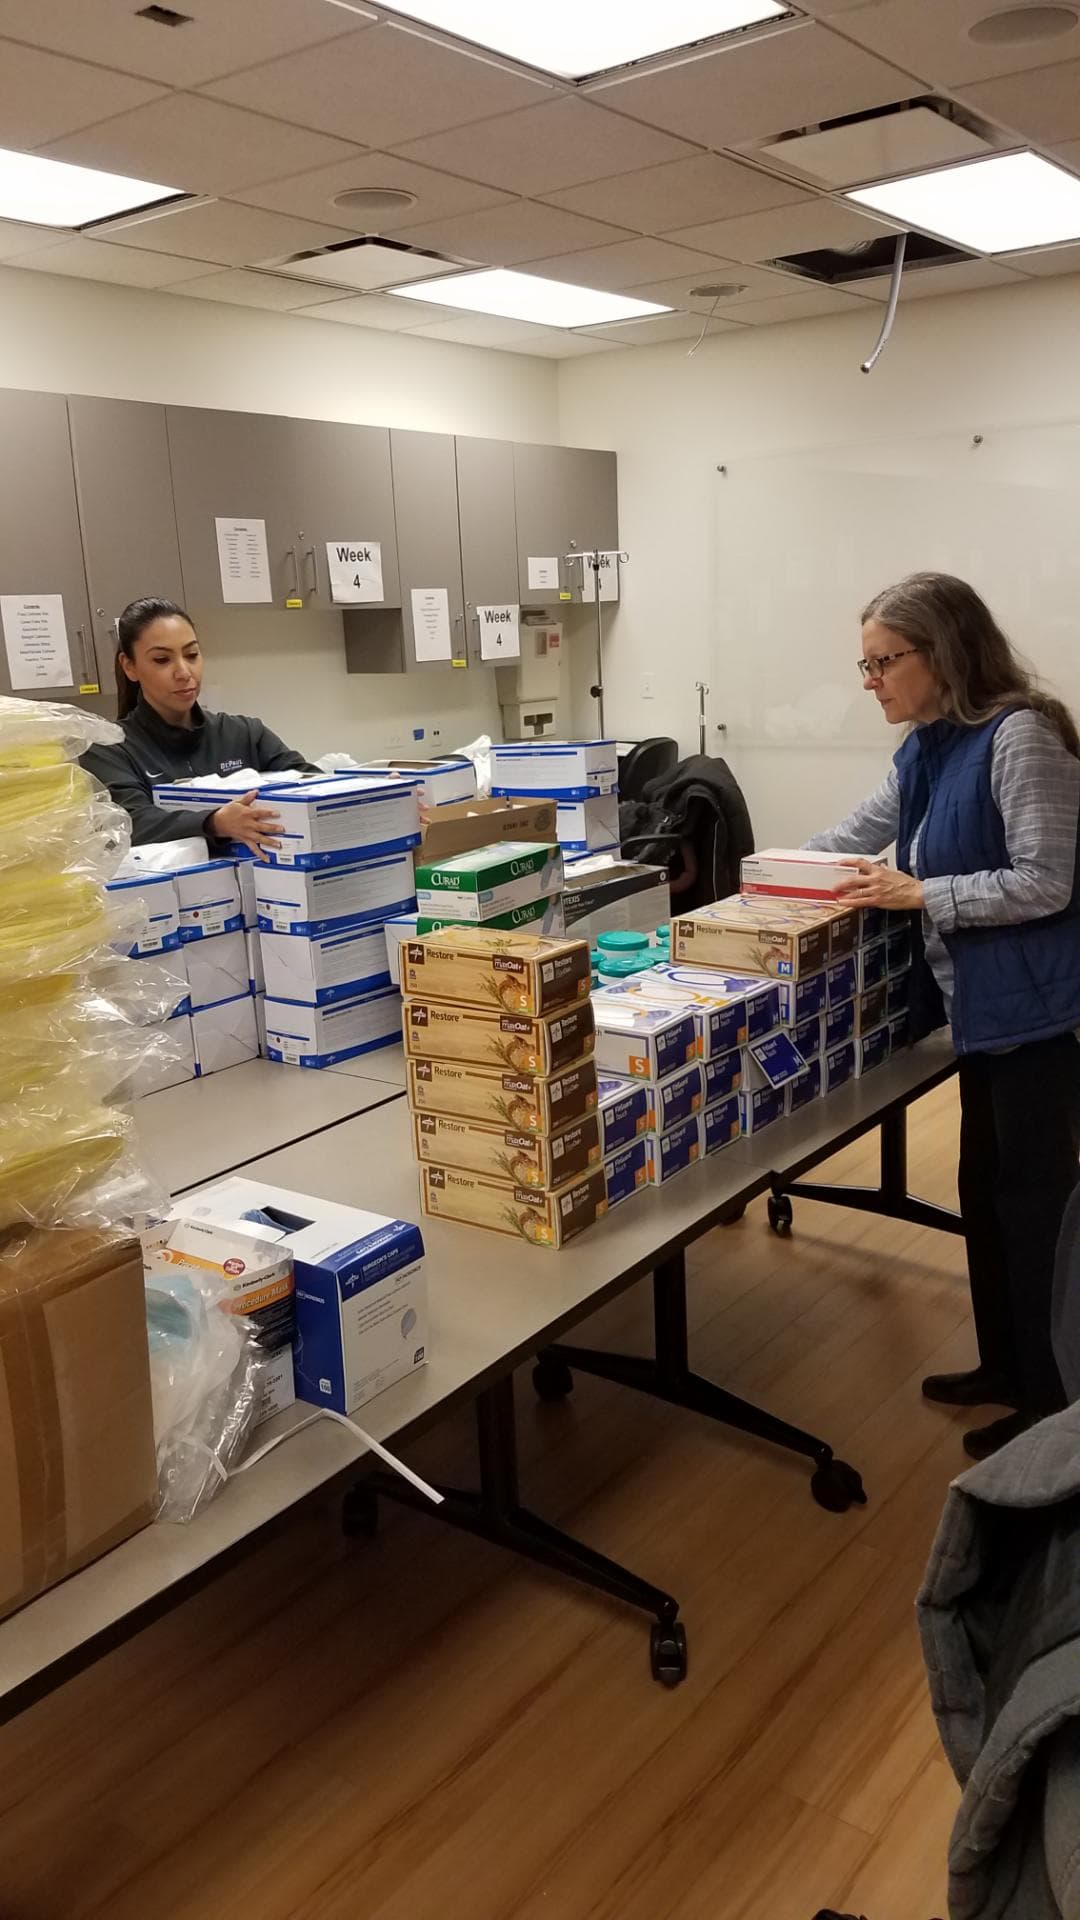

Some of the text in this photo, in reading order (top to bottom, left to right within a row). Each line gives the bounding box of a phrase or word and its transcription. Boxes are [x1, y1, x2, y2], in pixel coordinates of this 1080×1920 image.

[336, 547, 372, 562] Week
[586, 554, 610, 568] Wek
[353, 574, 361, 588] 4
[484, 610, 511, 623] Week
[496, 633, 503, 646] 4
[431, 872, 460, 886] CURAD
[696, 924, 722, 936] Restore
[426, 948, 454, 960] Restore
[780, 962, 791, 973] M
[581, 979, 586, 990] S
[520, 995, 527, 1007] S
[430, 1010, 460, 1022] Restore
[528, 1056, 536, 1068] S
[635, 1059, 644, 1073] S
[434, 1066, 462, 1079] Restore
[438, 1119, 466, 1133] Restore
[530, 1115, 537, 1127] S
[447, 1174, 475, 1188] Restore
[531, 1170, 539, 1182] S
[541, 1227, 548, 1238] S
[242, 1272, 275, 1288] Kimberly-Clark
[271, 1283, 290, 1299] Mask
